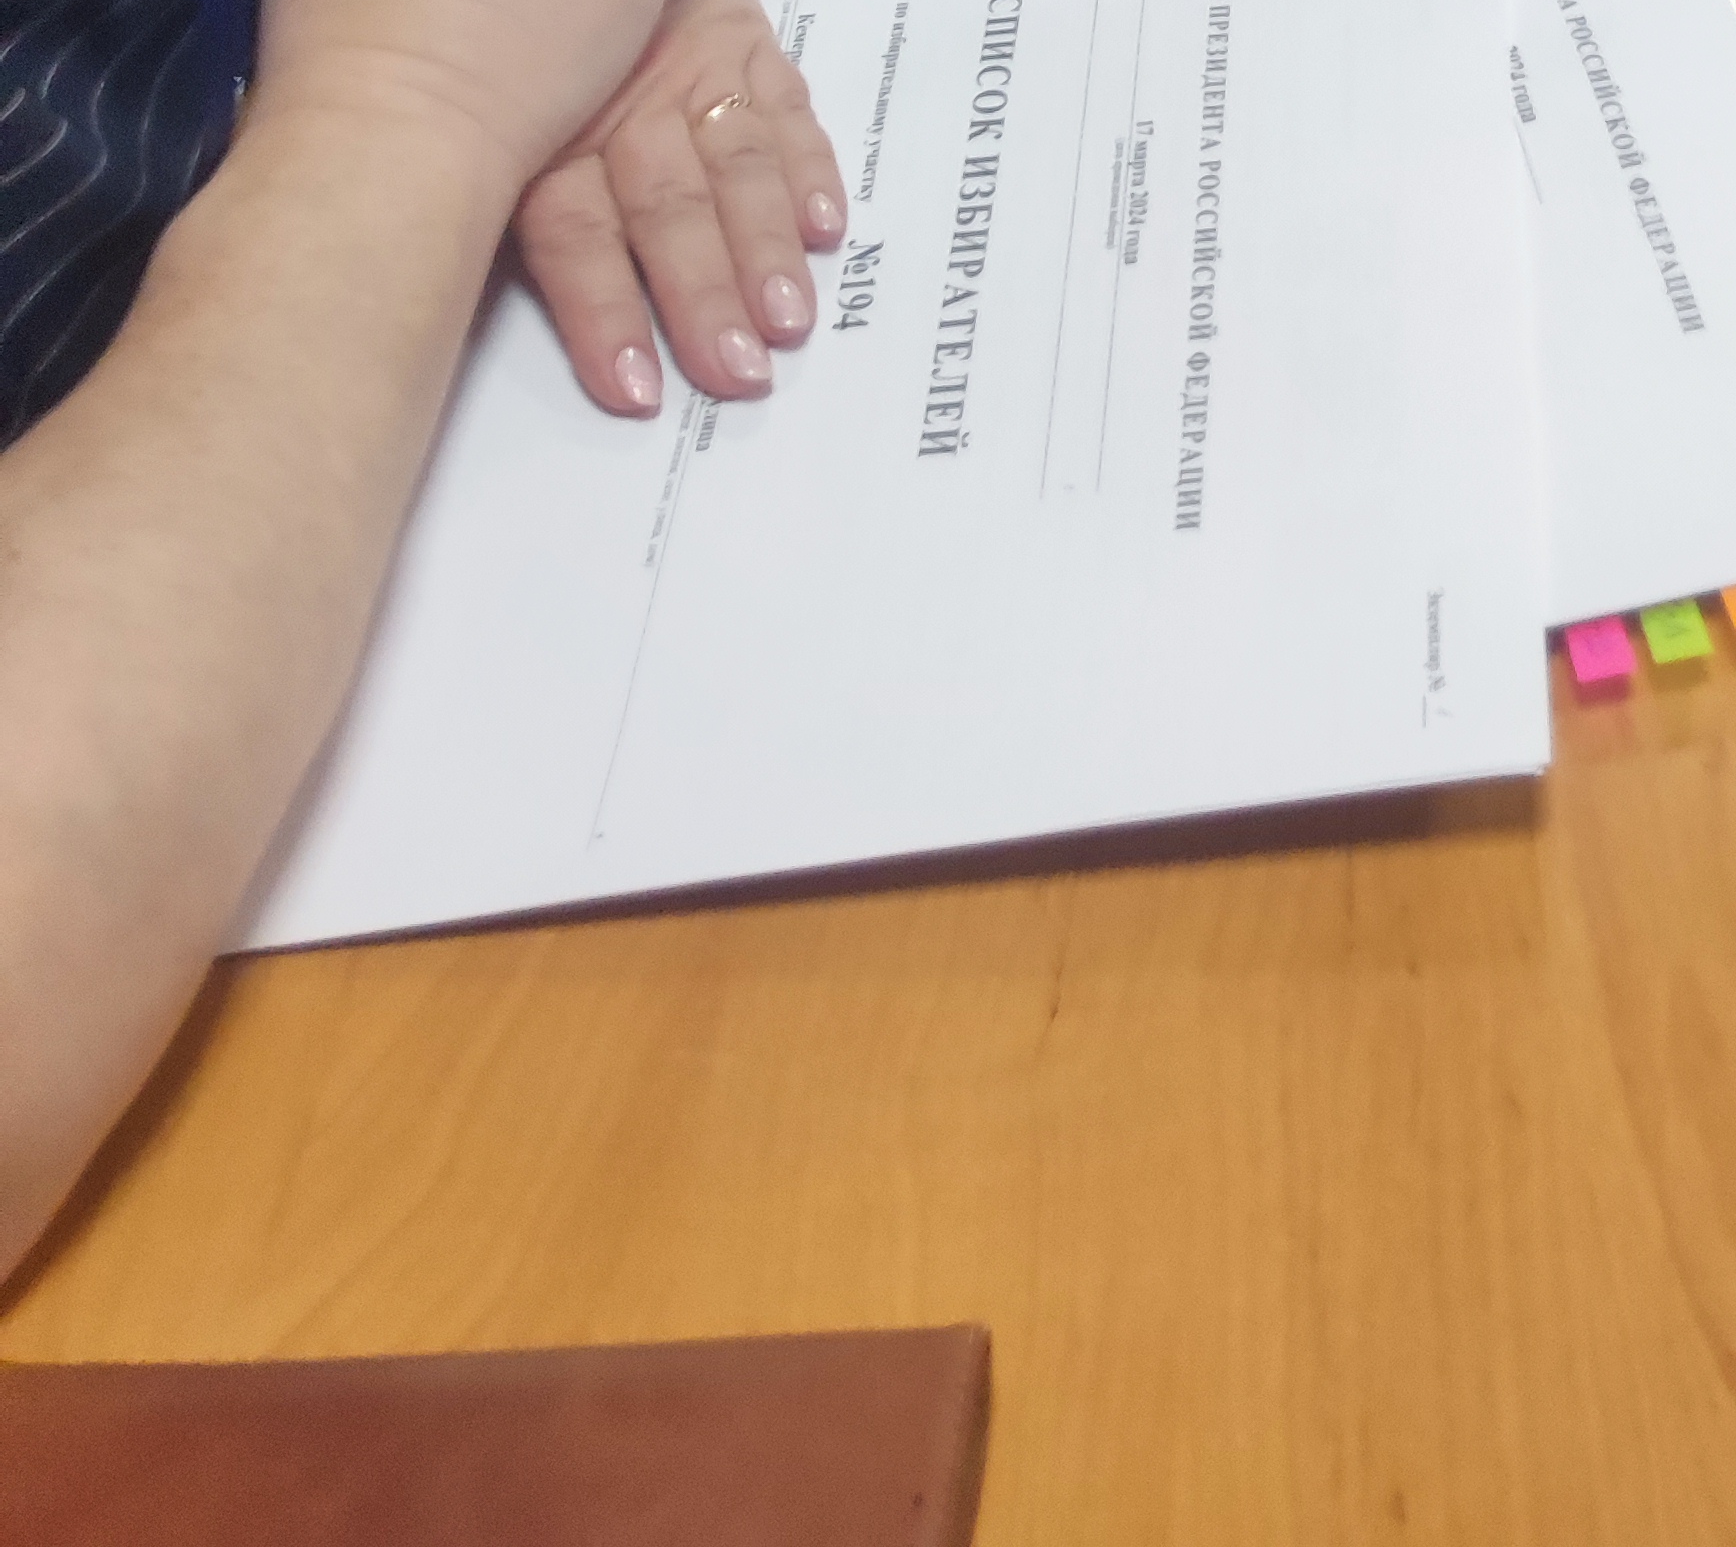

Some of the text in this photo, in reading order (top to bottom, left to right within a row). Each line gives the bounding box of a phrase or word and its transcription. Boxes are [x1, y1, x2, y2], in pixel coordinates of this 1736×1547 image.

[830, 2, 910, 333] по избирательному участку №194
[1198, 5, 1230, 153] ПРЕЗИДЕНТА
[1123, 120, 1154, 266] 17 марта 2024 года
[1186, 160, 1222, 342] РОССИЙСКОЙ
[1565, 15, 1647, 170] РОССИЙСКОЙ
[1627, 177, 1706, 335] ФЕДЕРАЦИИ
[915, 153, 1000, 459] ИЗБИРАТЕЛЕЙ
[1171, 351, 1211, 532] ФЕДЕРАЦИИ
